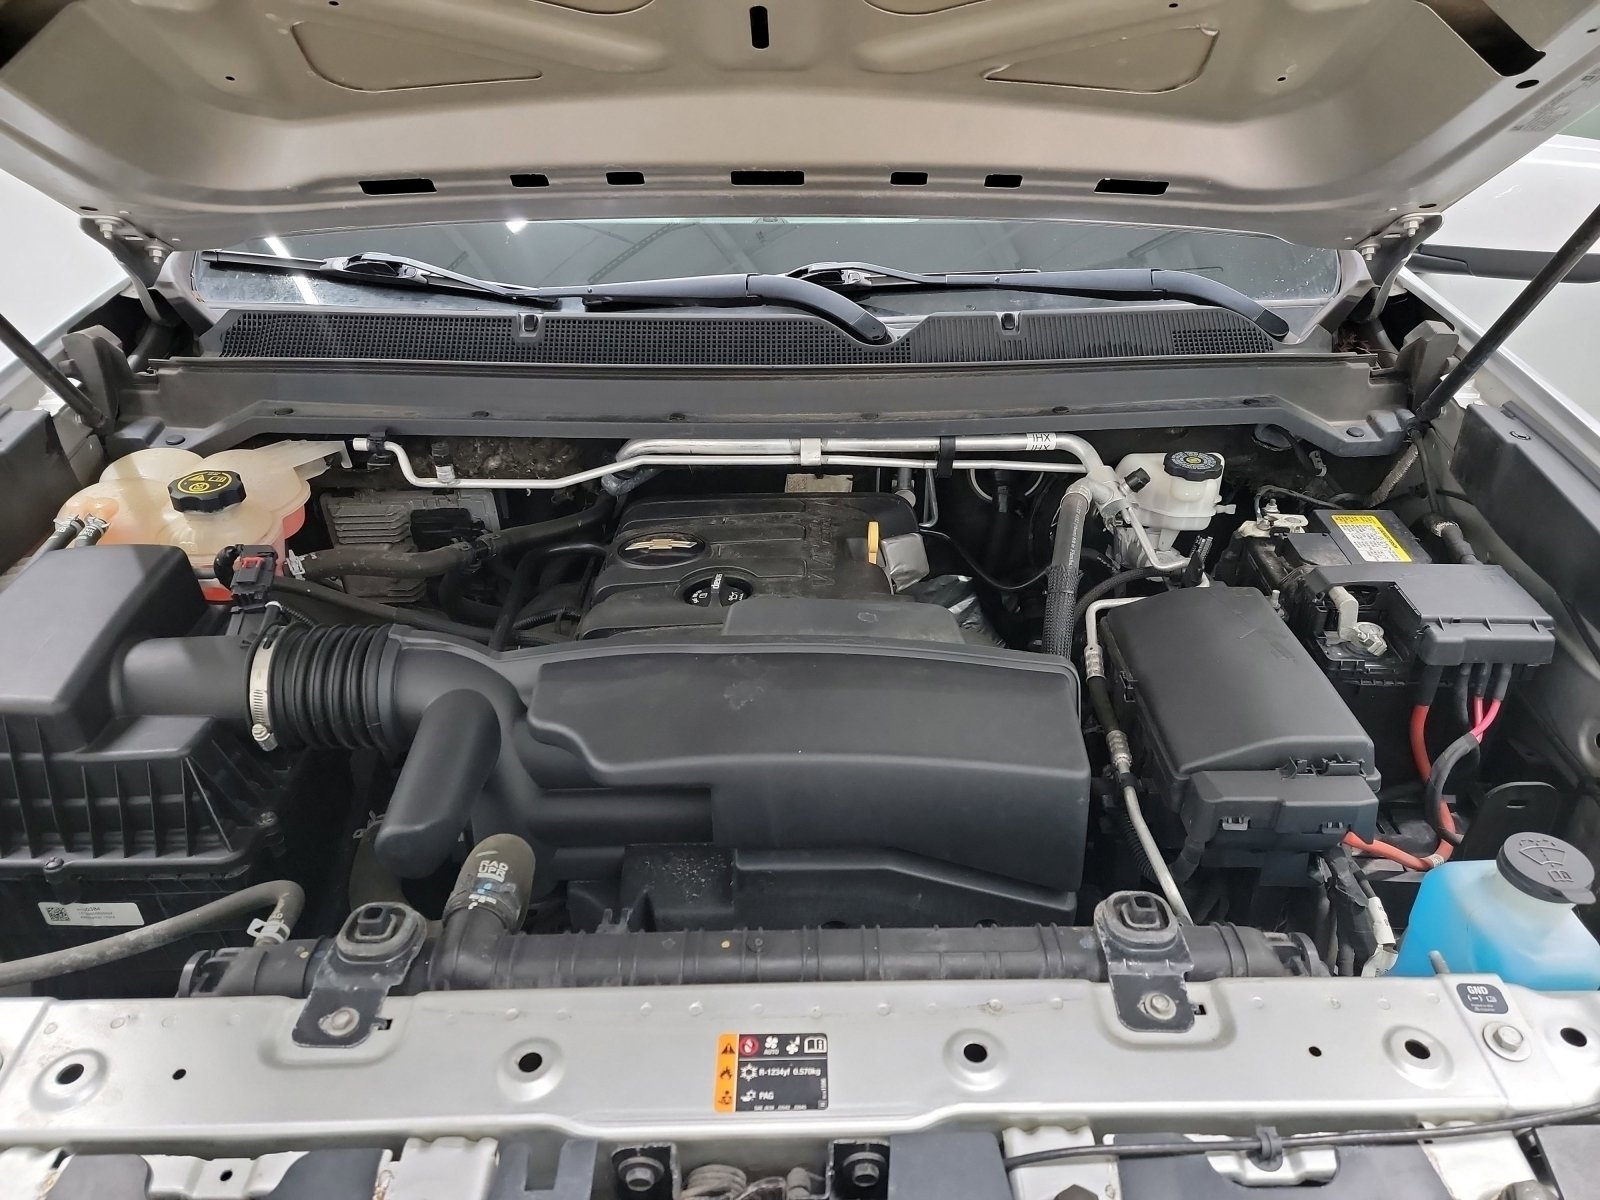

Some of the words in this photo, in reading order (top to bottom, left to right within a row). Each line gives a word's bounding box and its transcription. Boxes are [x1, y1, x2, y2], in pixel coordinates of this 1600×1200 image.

[480, 860, 509, 871] RAD
[478, 866, 507, 878] UPR
[1466, 985, 1489, 994] GND
[763, 1048, 779, 1056] AUTO
[758, 1066, 790, 1077] R-1234yf
[758, 1091, 774, 1100] PAG
